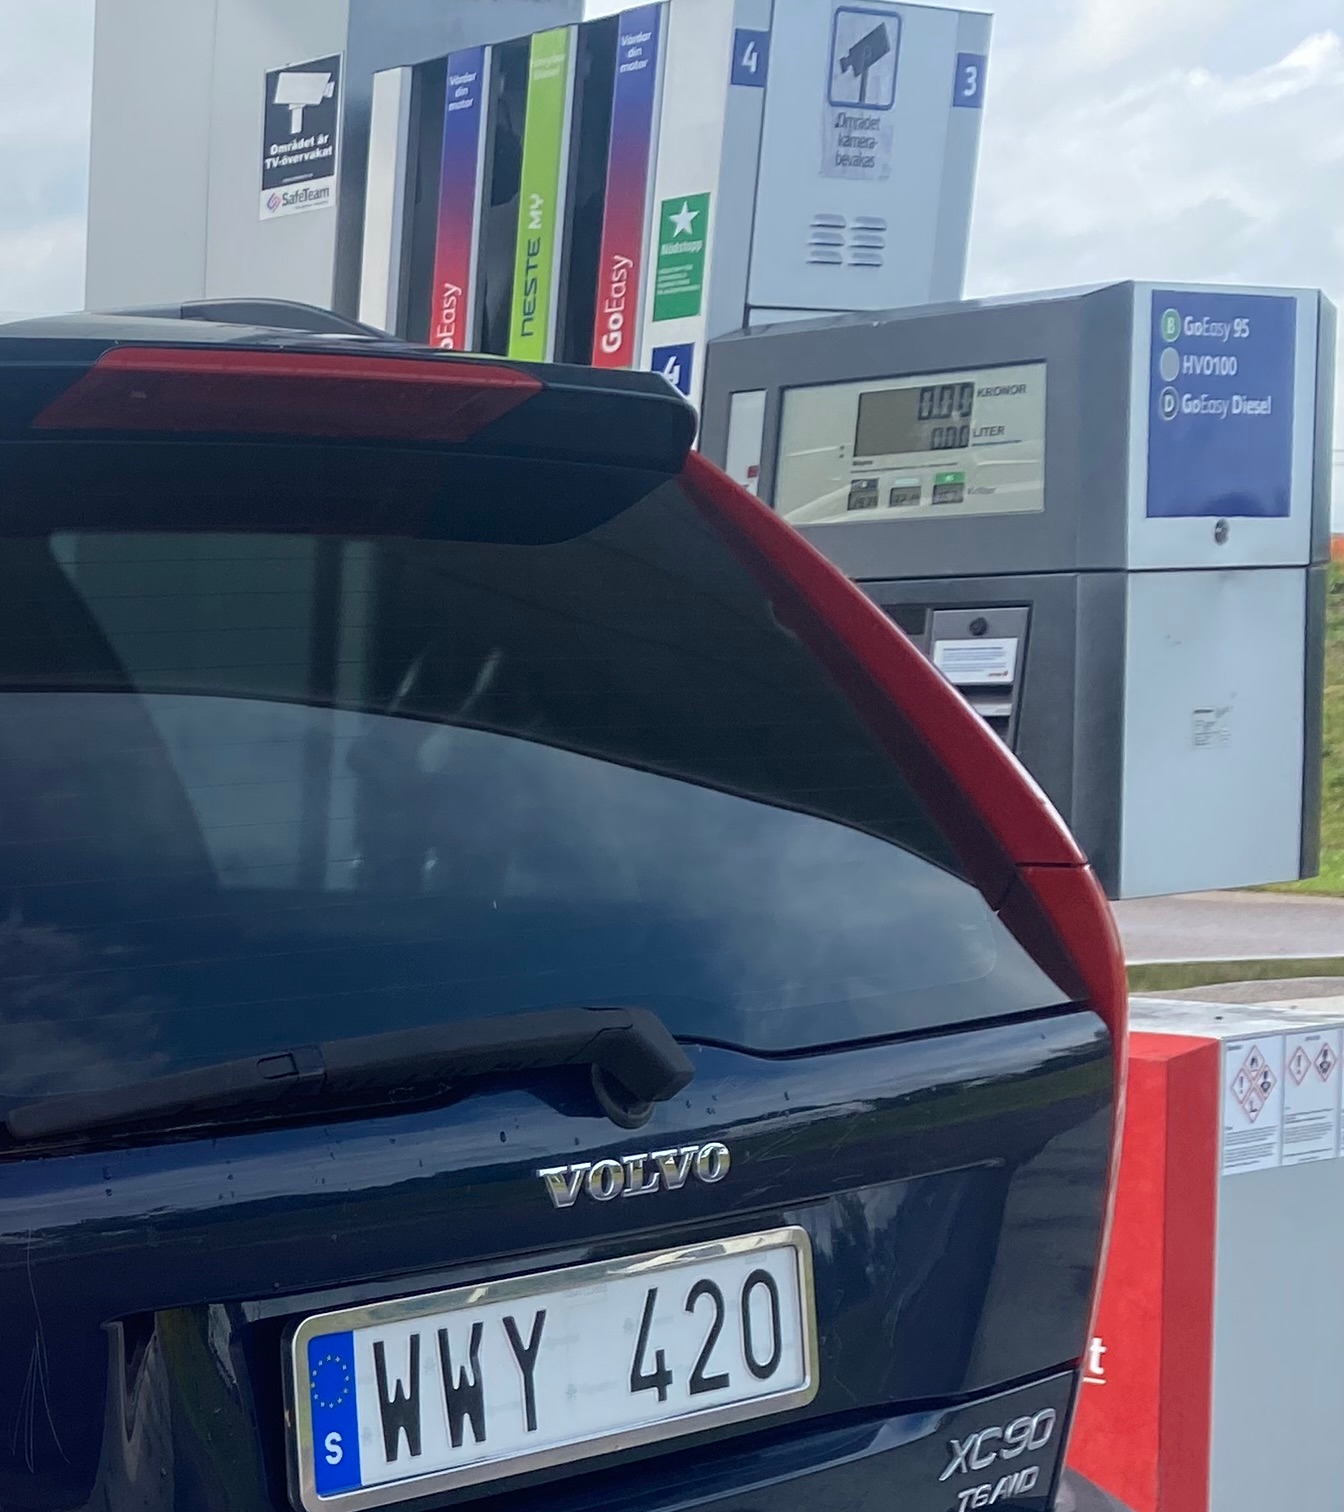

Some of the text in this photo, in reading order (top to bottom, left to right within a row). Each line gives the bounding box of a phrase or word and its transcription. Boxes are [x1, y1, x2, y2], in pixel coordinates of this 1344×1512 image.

[742, 41, 759, 74] 4
[963, 66, 978, 97] 3
[270, 136, 315, 155] Området
[282, 186, 330, 207] SafeTeam
[436, 282, 462, 349] Easy
[602, 255, 633, 353] GoEasy
[1167, 316, 1250, 342] B GoEasy 95
[663, 355, 681, 385] 4
[1182, 355, 1238, 376] HVO100
[1164, 393, 1272, 419] D GoEasy Diesel
[972, 425, 1005, 438] LITER
[536, 1142, 731, 1208] VOLVO
[372, 1268, 783, 1463] WWY 420
[325, 1431, 343, 1465] S
[938, 1407, 1056, 1482] XC90
